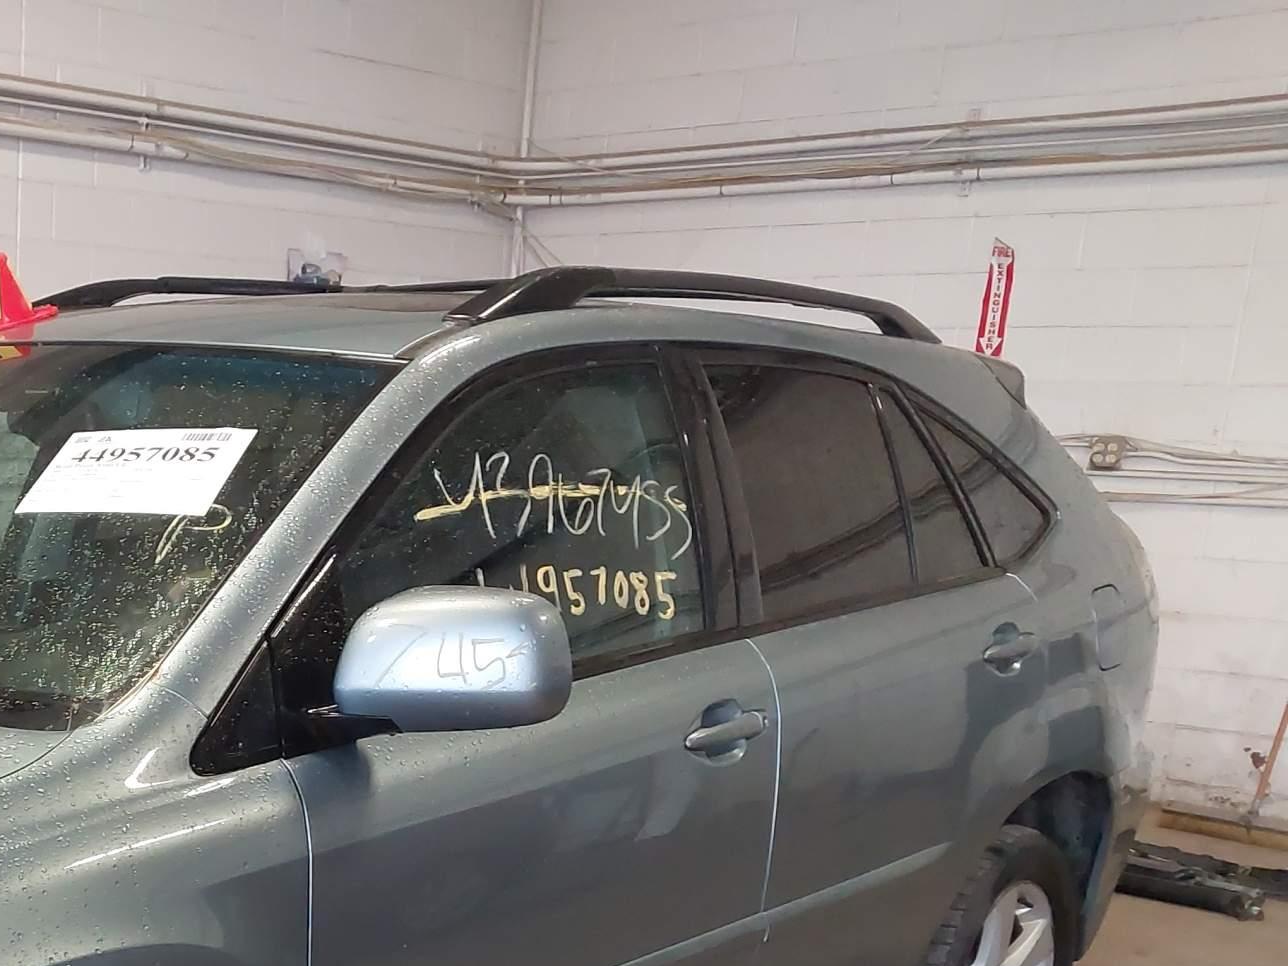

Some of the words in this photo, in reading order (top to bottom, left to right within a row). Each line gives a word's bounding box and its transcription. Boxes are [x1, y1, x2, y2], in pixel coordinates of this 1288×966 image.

[992, 246, 1012, 258] FIRE
[985, 263, 1004, 350] EXTINGUISHER
[71, 446, 220, 464] 44957085
[474, 563, 678, 620] 957085
